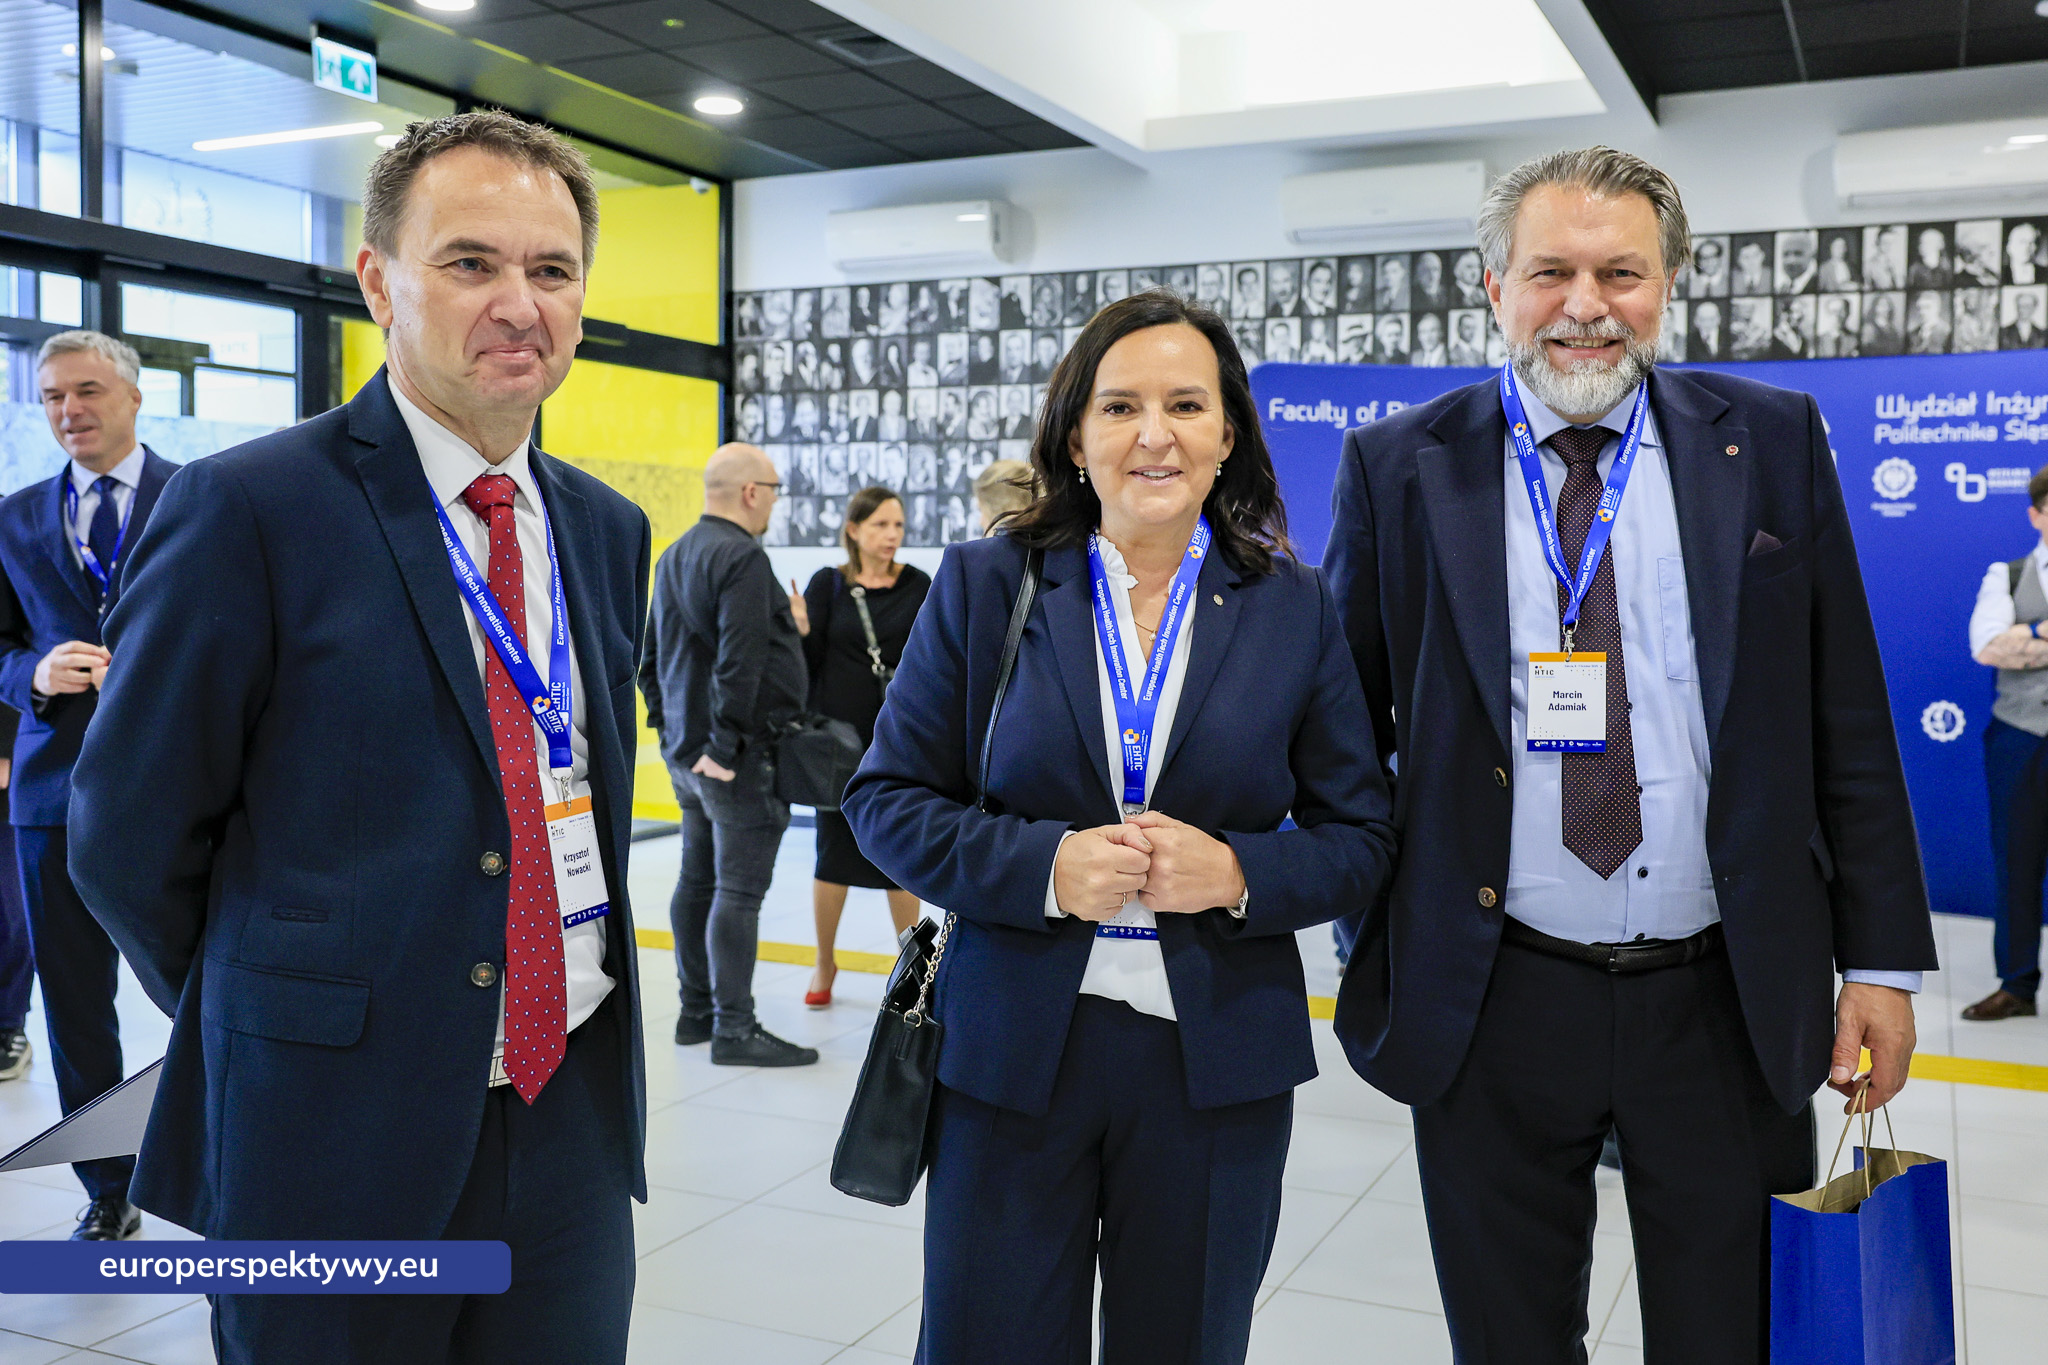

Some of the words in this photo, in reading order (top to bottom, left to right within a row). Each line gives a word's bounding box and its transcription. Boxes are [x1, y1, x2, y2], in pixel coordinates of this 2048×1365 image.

[1268, 398, 1348, 429] Faculty
[1355, 400, 1379, 424] of
[1875, 391, 1978, 425] Wydział
[1522, 433, 1534, 456] EHTIC
[1874, 421, 1998, 444] Politechnika
[1619, 434, 1636, 465] European
[1600, 486, 1614, 508] EHTIC
[1191, 524, 1204, 545] EHTIC
[1532, 479, 1544, 510] European
[1540, 509, 1554, 546] HealthTech
[1549, 544, 1567, 580] Innovation
[1583, 547, 1596, 571] Center
[553, 557, 562, 604] HealthTech
[449, 547, 479, 594] HealthTech
[475, 592, 506, 638] Innovation
[502, 635, 522, 665] Center
[555, 605, 564, 646] European
[1096, 578, 1108, 610] European
[1103, 609, 1116, 645] HealthTech
[1110, 644, 1123, 678] Innovation
[1118, 678, 1128, 700] Center
[1142, 673, 1158, 701] European
[1152, 640, 1168, 674] HealthTech
[1162, 605, 1178, 641] Innovation
[1172, 581, 1187, 605] Center
[1548, 703, 1587, 711] Adamiak
[1552, 690, 1583, 699] Marcin
[546, 709, 564, 733] EHTIC
[1132, 745, 1143, 771] EHTIC
[563, 847, 589, 863] Krzysztof
[567, 862, 591, 877] Nowacki
